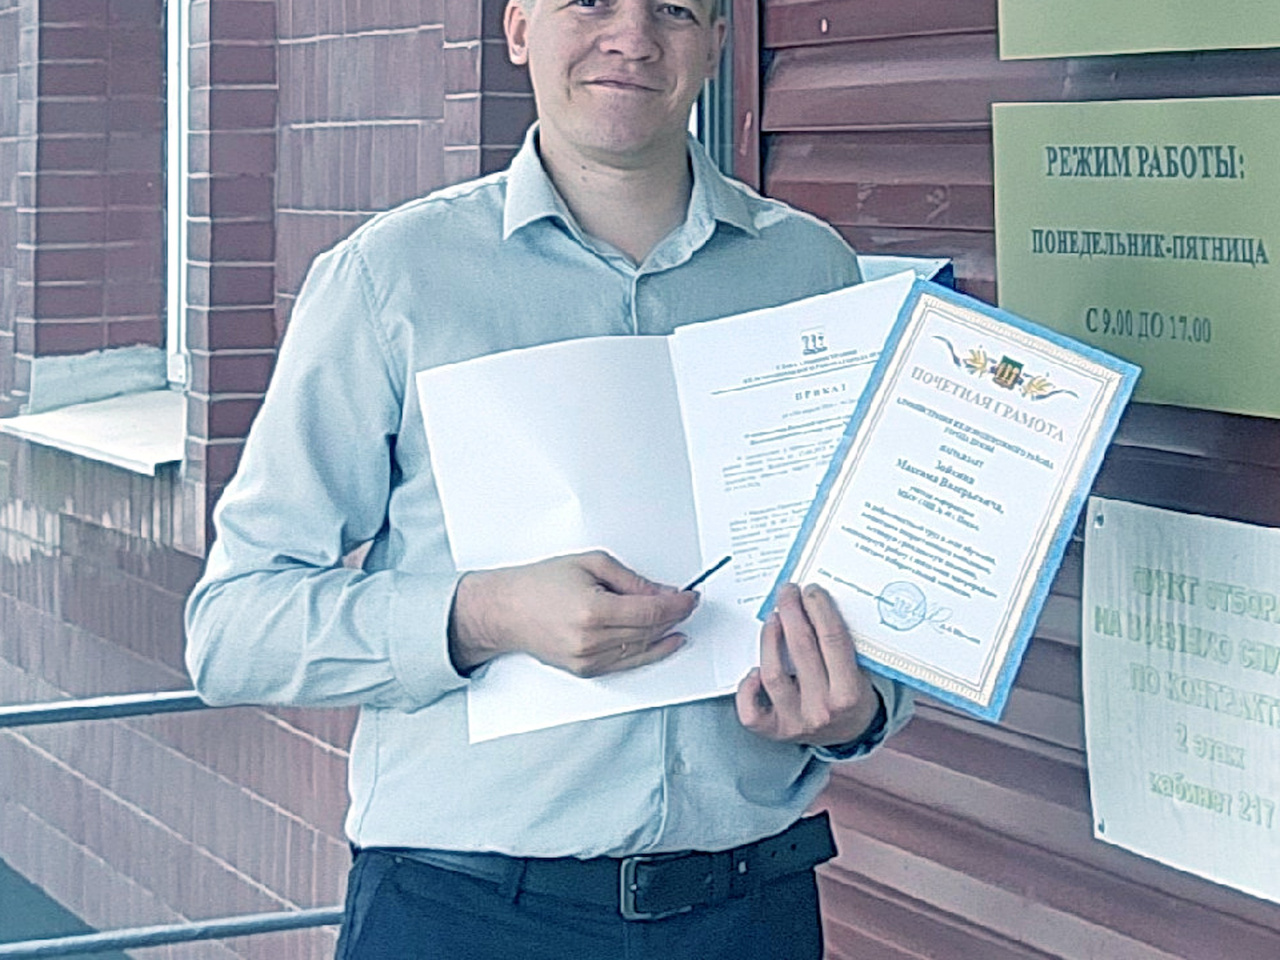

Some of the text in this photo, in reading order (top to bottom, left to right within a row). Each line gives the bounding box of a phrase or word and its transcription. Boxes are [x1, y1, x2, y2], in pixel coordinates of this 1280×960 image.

[1045, 144, 1245, 179] РЕЖИМ РАБОТЫ:
[1031, 229, 1270, 268] ПОНЕДЕЛЬНИК-ПЯТНИЦА
[1085, 307, 1212, 343] С 9.00 ДО 17.00
[994, 401, 1064, 442] ГРАМОТА
[1094, 605, 1123, 638] НА
[1129, 661, 1161, 695] ПО
[1176, 722, 1246, 770] 2 этаж
[1149, 771, 1276, 829] кабинет 217
